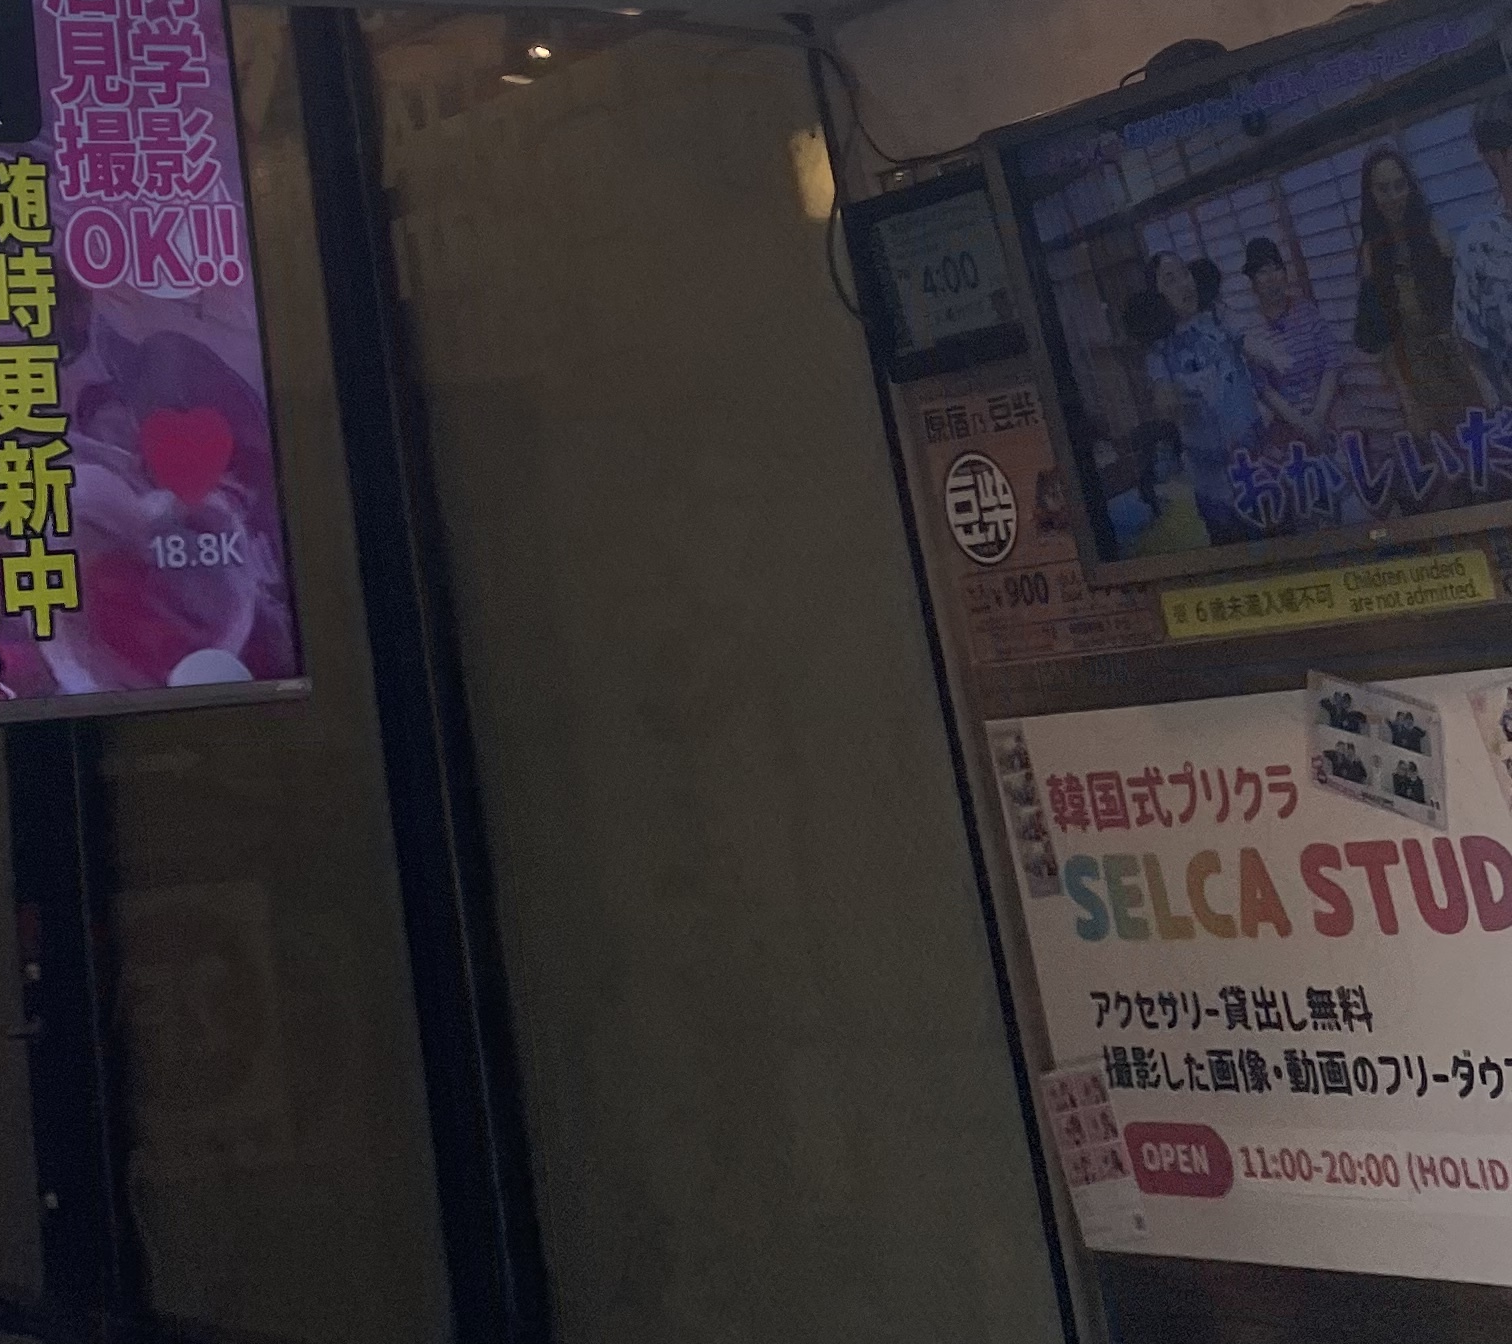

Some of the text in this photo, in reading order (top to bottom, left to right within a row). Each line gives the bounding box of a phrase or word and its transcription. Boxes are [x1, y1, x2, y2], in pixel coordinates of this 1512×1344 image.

[65, 204, 244, 288] OK!!
[150, 531, 245, 569] 18.8K
[1343, 569, 1408, 592] Children
[1349, 596, 1374, 613] are
[1376, 591, 1402, 611] not
[1046, 761, 1299, 833] 韓国式プリクラ
[1064, 835, 1512, 942] SELCA STUD
[1089, 985, 1374, 1034] アクセサリー貸出し無料
[1103, 1046, 1512, 1099] 撮影した画像・動画のフリーダウ
[1141, 1141, 1210, 1177] OPEN
[1240, 1144, 1401, 1188] 11:00-20:00
